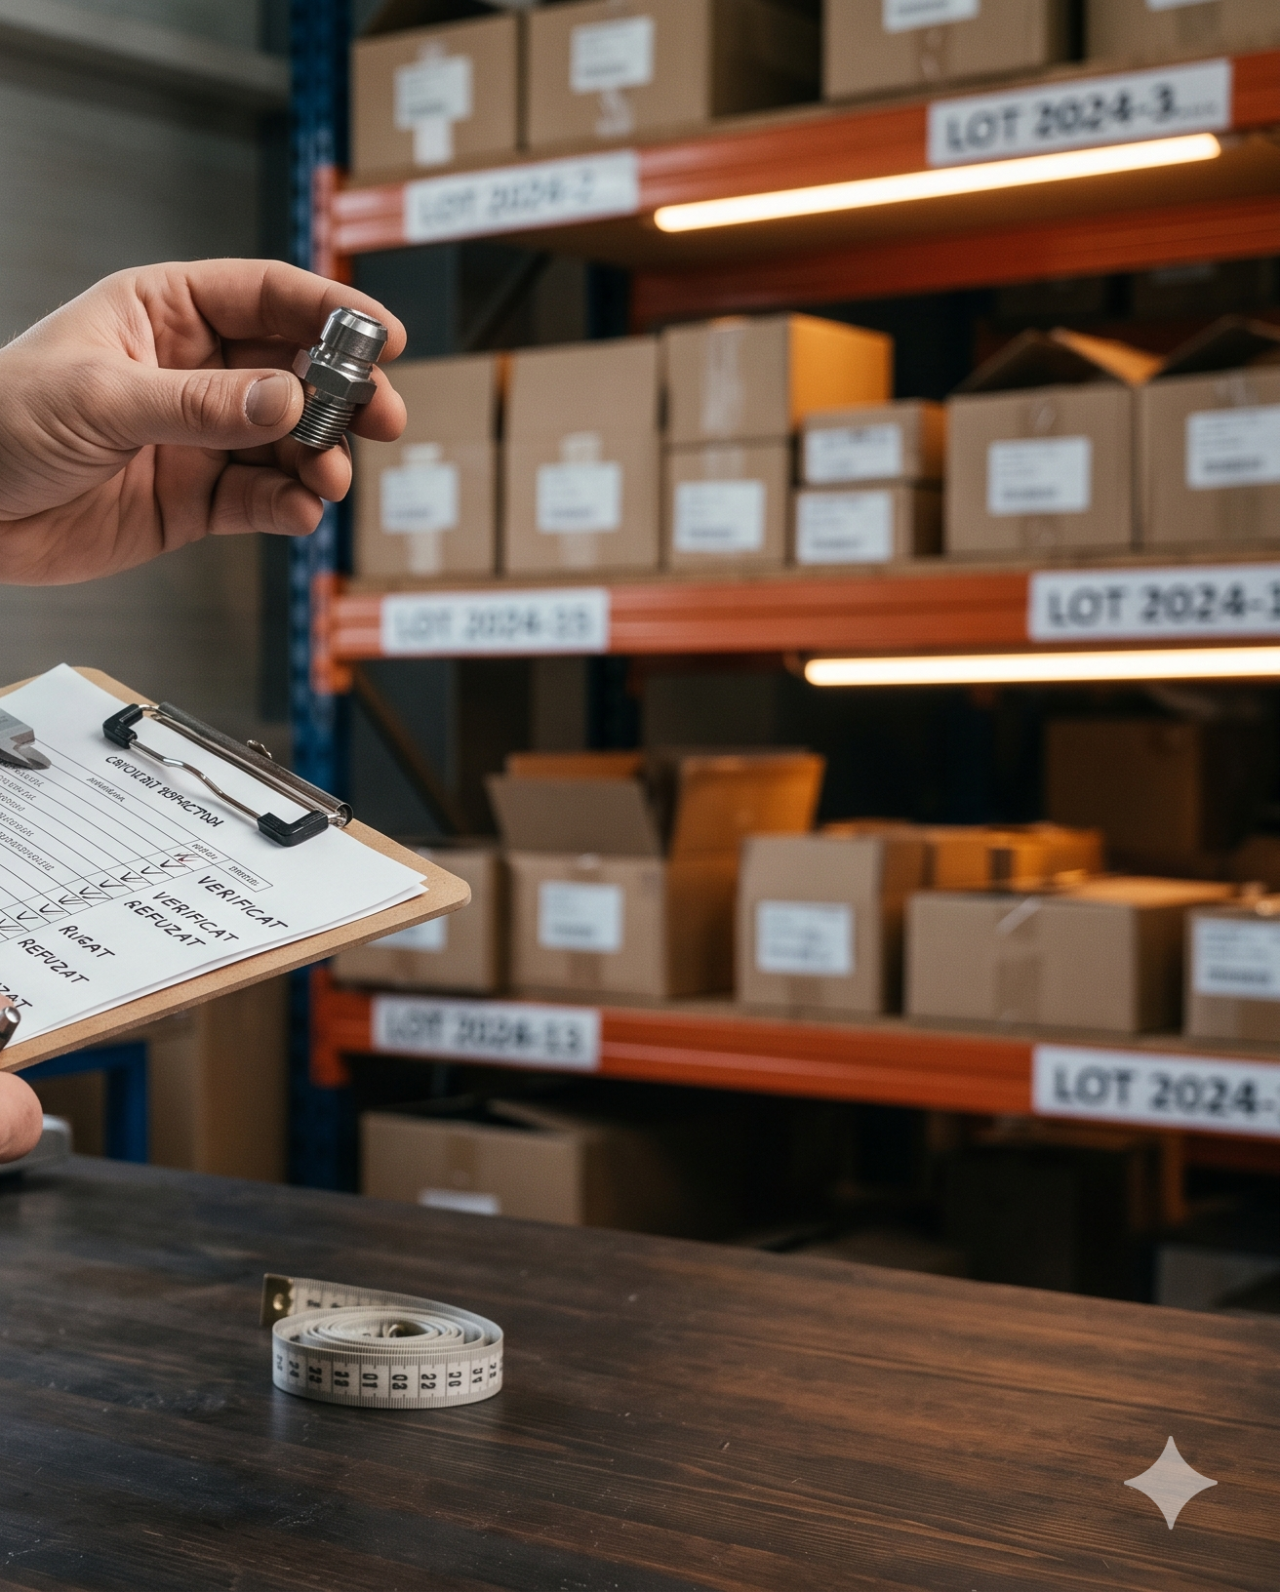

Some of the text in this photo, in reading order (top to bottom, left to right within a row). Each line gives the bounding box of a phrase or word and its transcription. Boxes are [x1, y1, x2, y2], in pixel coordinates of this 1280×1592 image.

[945, 103, 1021, 152] LOT
[394, 606, 452, 642] LOT
[1048, 585, 1125, 628] LOT
[123, 899, 207, 946] REFUZAT
[152, 891, 240, 942] VERIFICAT
[197, 875, 289, 928] VERIFICAT
[17, 938, 90, 983] REFUZAT
[1053, 1063, 1280, 1120] LOT 2024-
